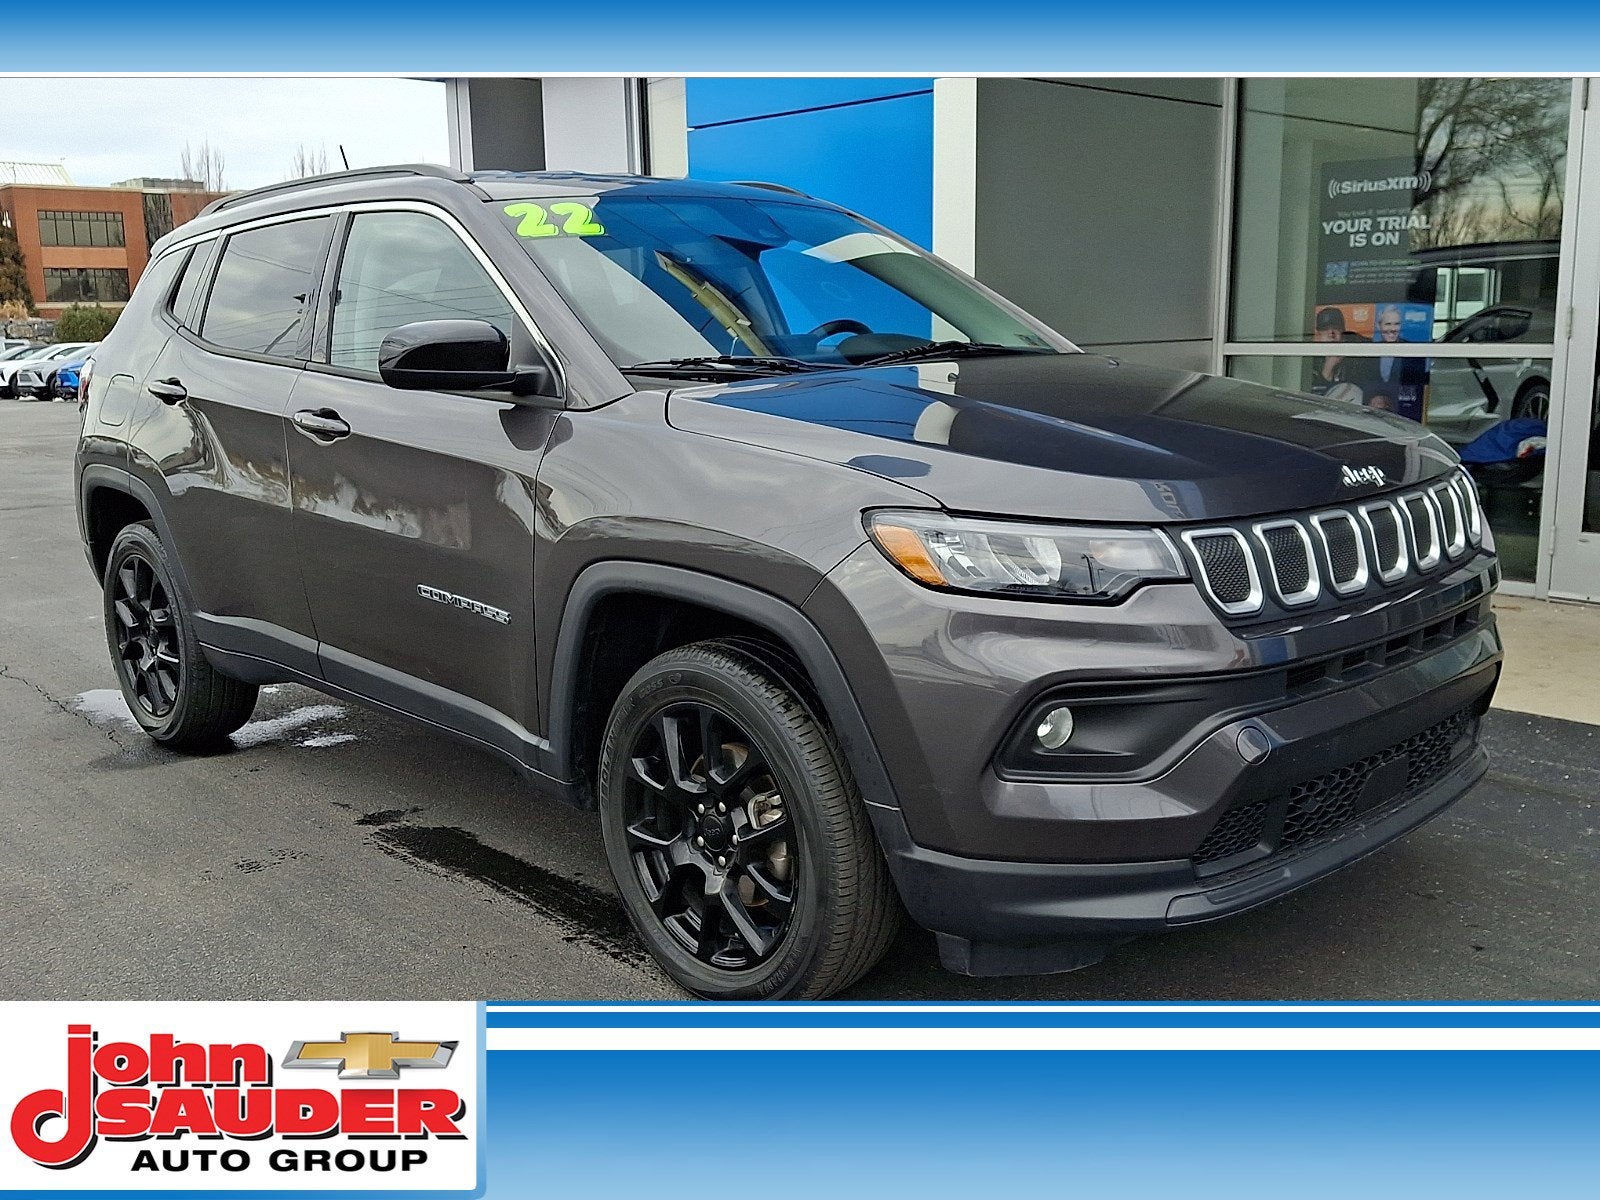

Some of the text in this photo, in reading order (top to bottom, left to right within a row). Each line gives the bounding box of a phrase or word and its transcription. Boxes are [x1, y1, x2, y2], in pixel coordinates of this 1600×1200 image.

[503, 202, 605, 237] 22
[1322, 214, 1431, 235] YOUR TRIAL
[1349, 231, 1400, 248] IS ON
[417, 584, 512, 625] COMPASS
